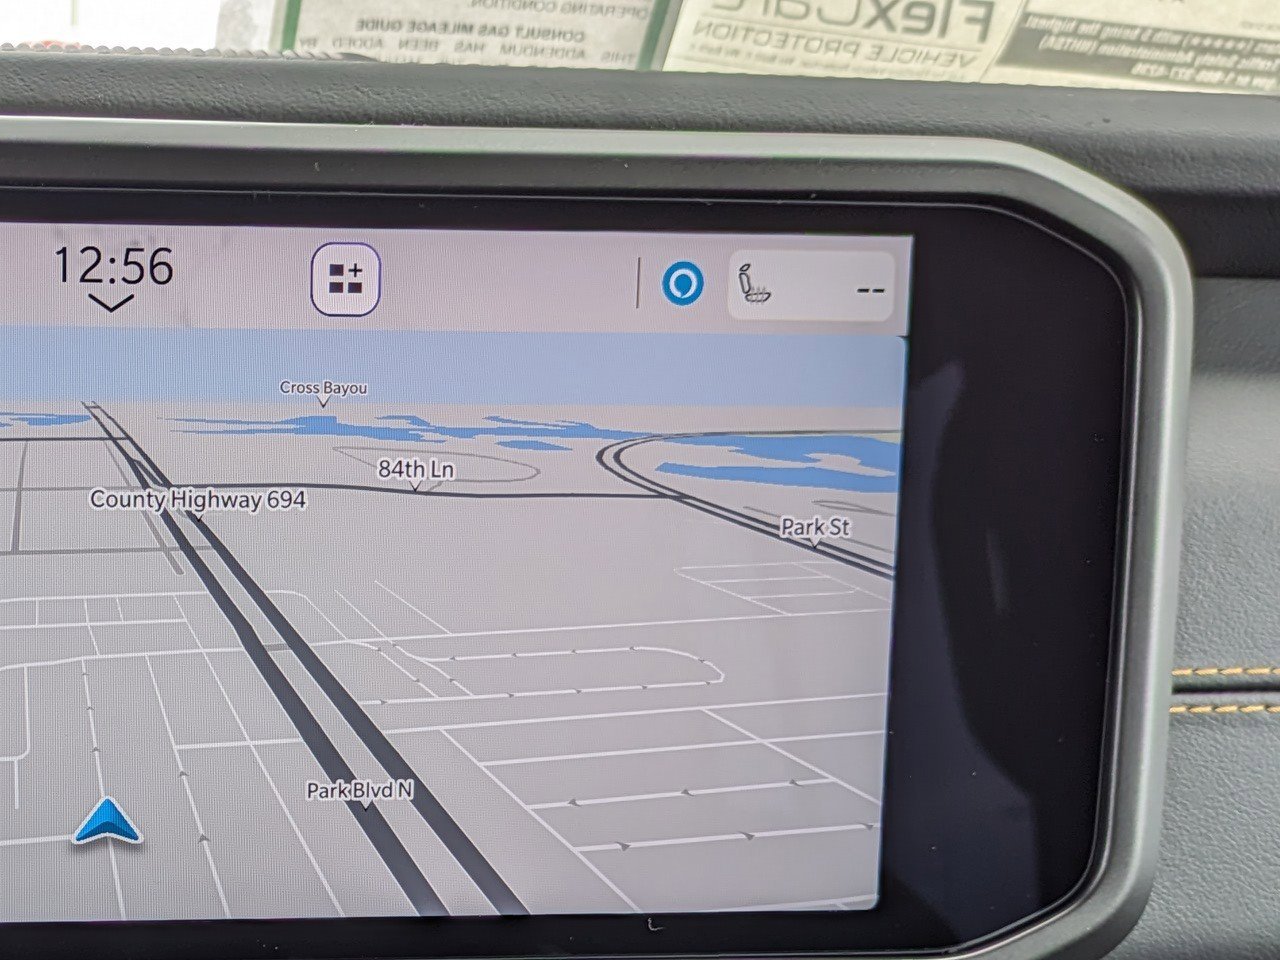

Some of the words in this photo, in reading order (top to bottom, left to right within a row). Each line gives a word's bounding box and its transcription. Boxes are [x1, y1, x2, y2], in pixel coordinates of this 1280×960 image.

[54, 246, 174, 286] 12:56
[279, 381, 320, 396] Cross
[323, 381, 368, 397] Bayou
[378, 460, 425, 480] 84th
[430, 460, 454, 480] Ln
[90, 489, 165, 512] County
[170, 489, 262, 512] Highway
[267, 489, 306, 509] 694
[782, 518, 825, 535] Park
[829, 518, 850, 536] St
[307, 782, 350, 800] Park
[353, 781, 391, 799] Blvd
[396, 781, 413, 799] N
